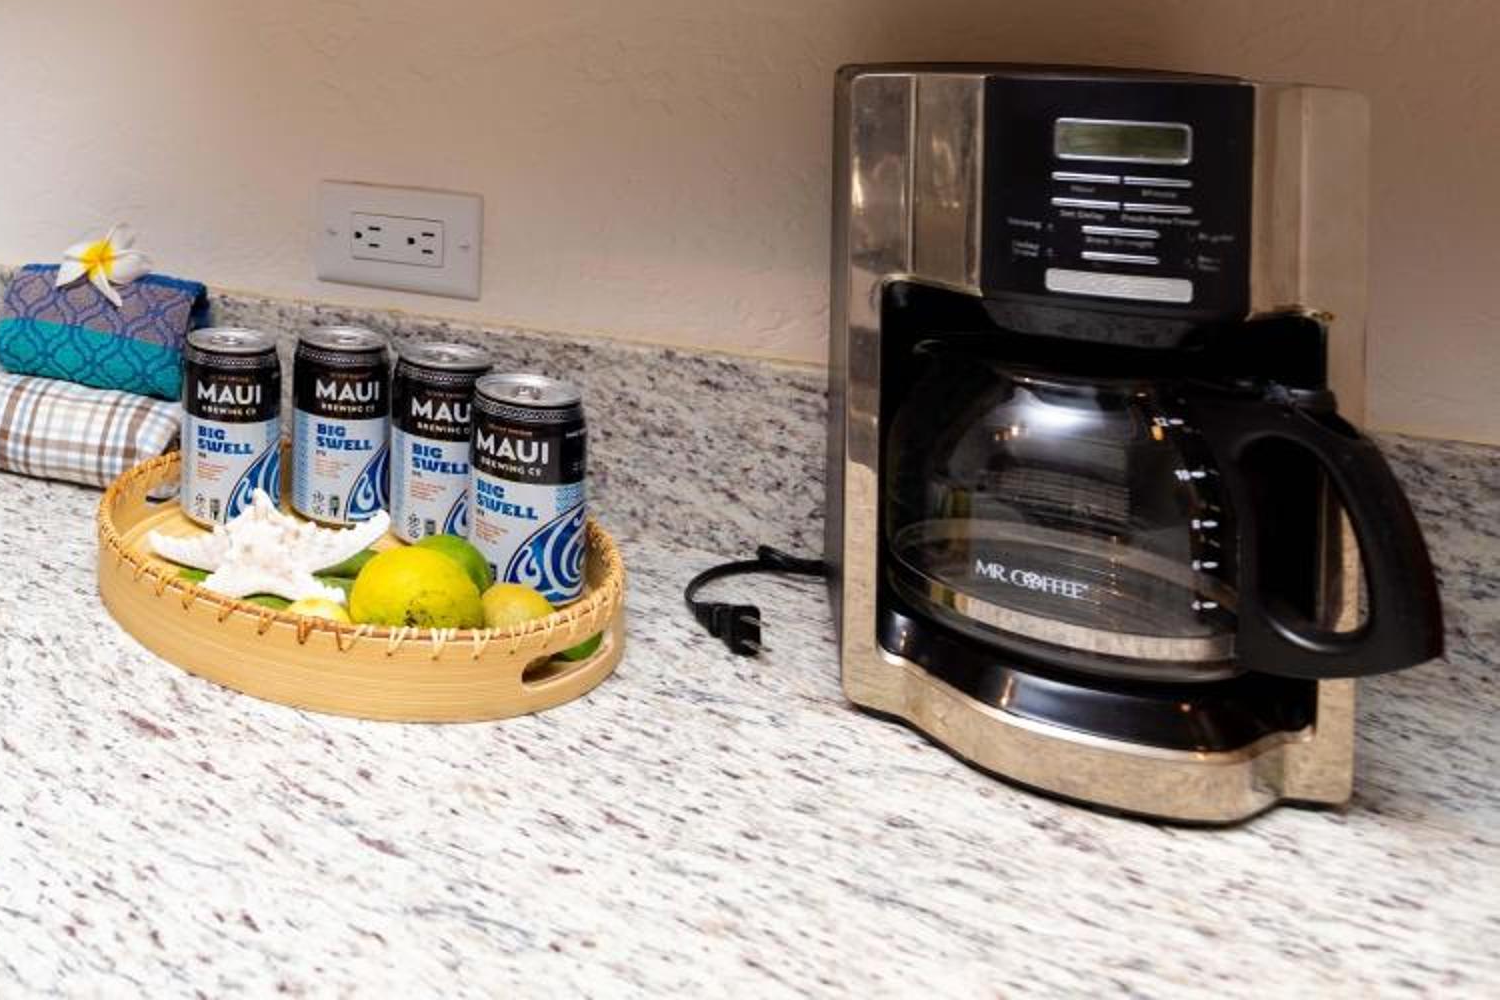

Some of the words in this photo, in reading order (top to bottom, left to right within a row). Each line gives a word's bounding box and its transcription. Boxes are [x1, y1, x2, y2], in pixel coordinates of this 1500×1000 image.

[197, 380, 261, 405] MAUI
[315, 379, 379, 402] MAUI
[202, 405, 243, 417] BREWING
[321, 402, 363, 413] BREWING
[411, 397, 471, 423] MAU
[197, 425, 226, 440] BIG
[317, 424, 346, 437] BIG
[417, 421, 461, 435] BREWING
[197, 439, 253, 454] SWELL
[316, 436, 373, 450] SWELL
[412, 443, 443, 458] BIG
[477, 428, 549, 465] MAUI
[481, 455, 525, 476] BREWING
[477, 479, 505, 499] BIG
[477, 494, 538, 520] SWELL
[1010, 569, 1085, 600] COFFEE
